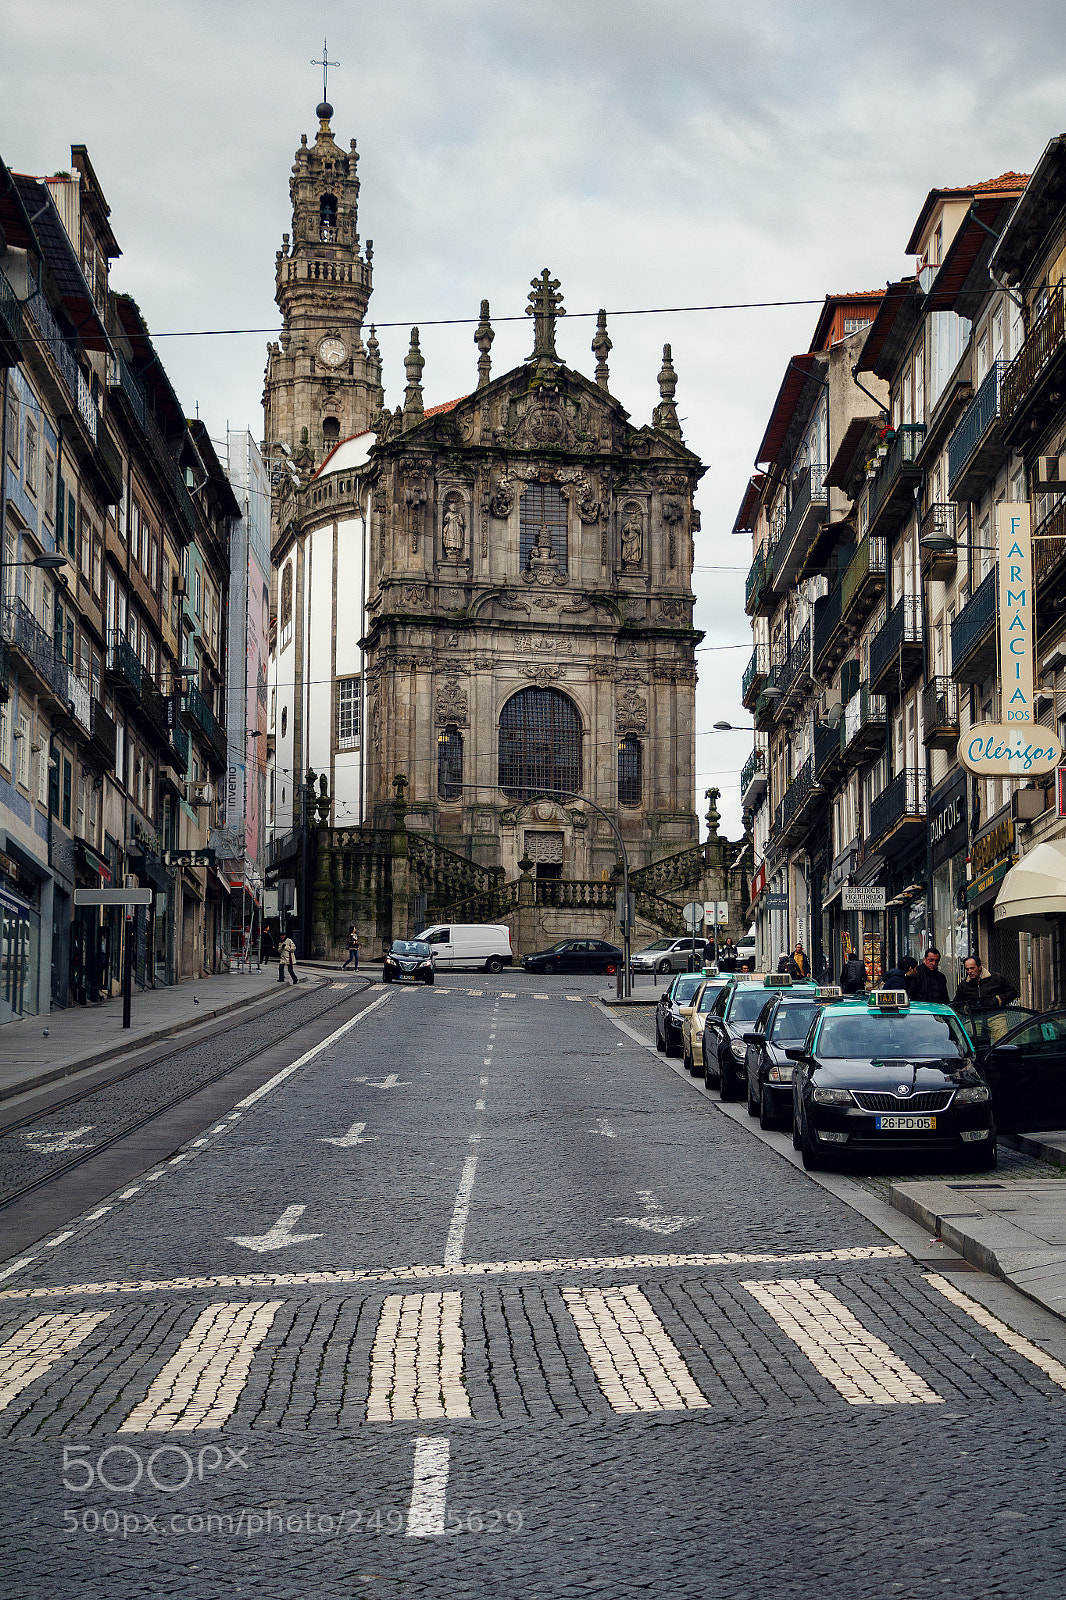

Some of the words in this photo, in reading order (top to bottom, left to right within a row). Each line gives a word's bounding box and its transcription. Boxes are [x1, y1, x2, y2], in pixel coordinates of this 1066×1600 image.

[1006, 516, 1028, 704] FARMÁCIA
[1007, 710, 1030, 721] DOS
[967, 736, 1058, 770] Clérigos
[228, 766, 237, 807] invenio
[161, 850, 210, 867] tela
[878, 993, 896, 1002] TAXI
